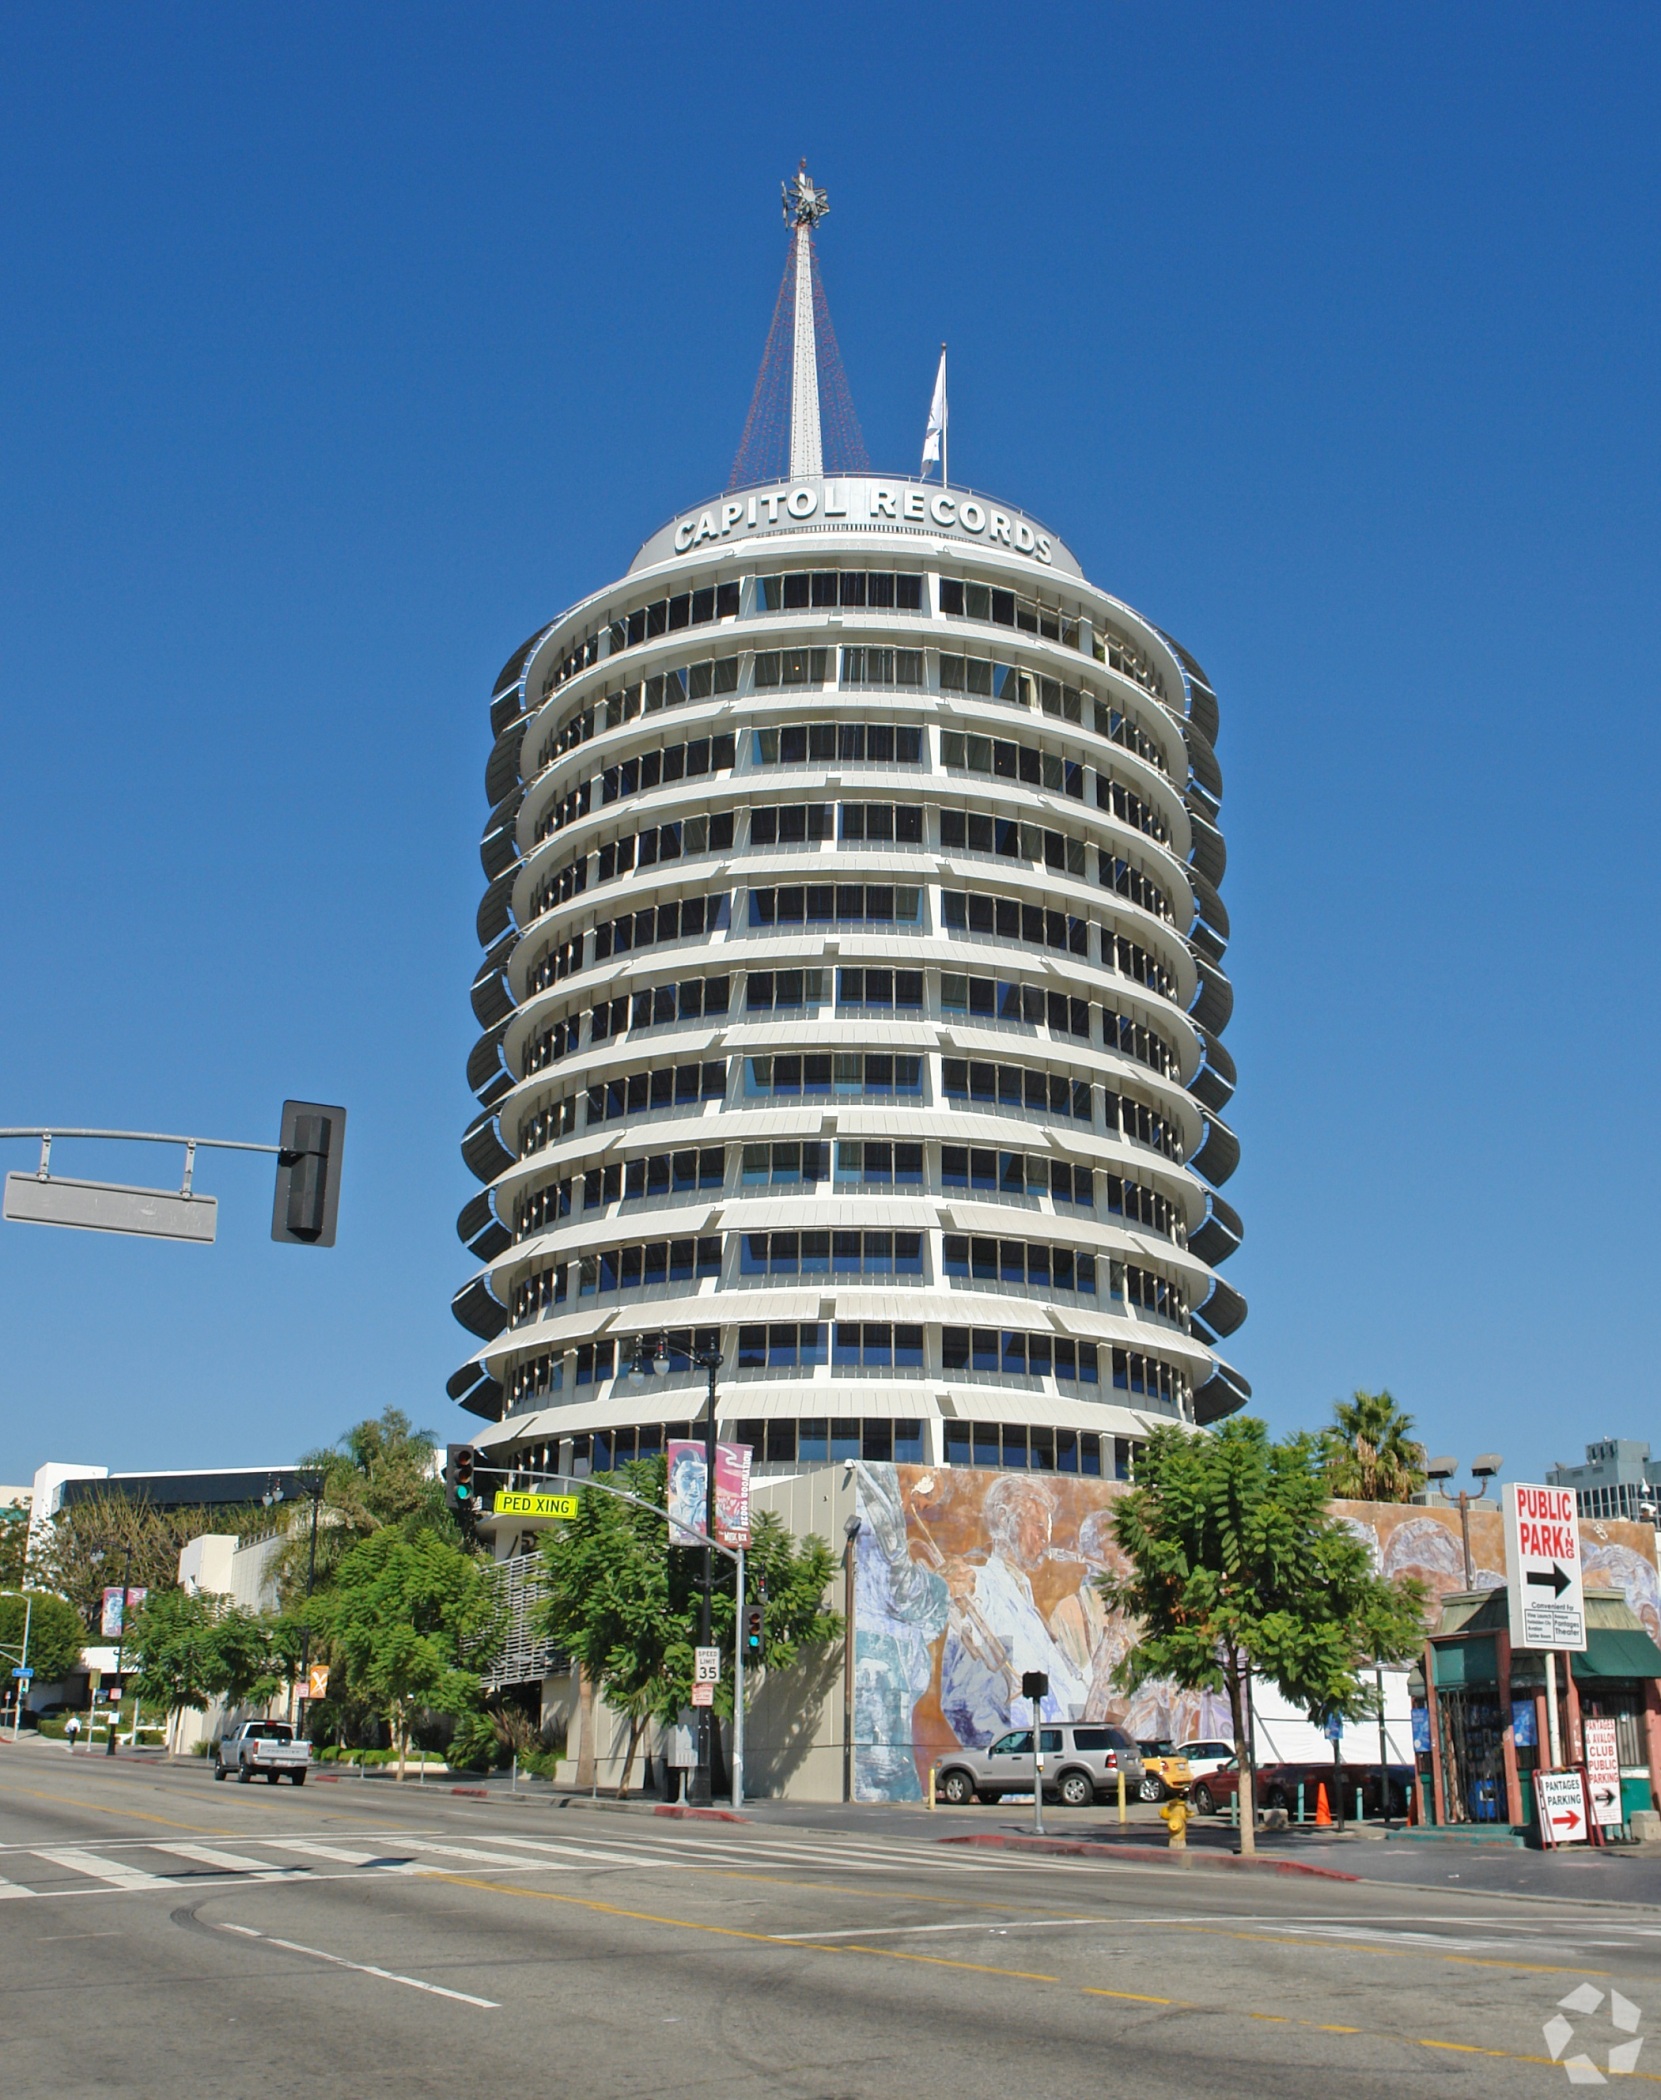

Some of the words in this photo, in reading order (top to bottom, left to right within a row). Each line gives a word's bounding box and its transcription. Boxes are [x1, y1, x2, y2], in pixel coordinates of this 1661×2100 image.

[674, 487, 847, 555] CAPITOL
[869, 487, 1053, 564] RECORDS
[741, 1450, 753, 1499] HOLLYWOOD
[503, 1496, 531, 1511] PED
[535, 1498, 570, 1514] XING
[1517, 1488, 1572, 1522] PUBLIC
[740, 1500, 750, 1527] 90028
[1531, 1601, 1566, 1610] Convenient
[1554, 1619, 1580, 1629] Pantages
[1555, 1627, 1580, 1637] Theater
[699, 1666, 717, 1679] 35
[1585, 1718, 1615, 1730] PANTAGES
[1592, 1732, 1616, 1744] AVALON
[1589, 1746, 1614, 1757] CLUB
[1588, 1759, 1617, 1770] PUBLIC
[1588, 1772, 1620, 1785] PARKING
[1545, 1779, 1580, 1791] PANTAGES
[1547, 1794, 1582, 1806] PARKING
